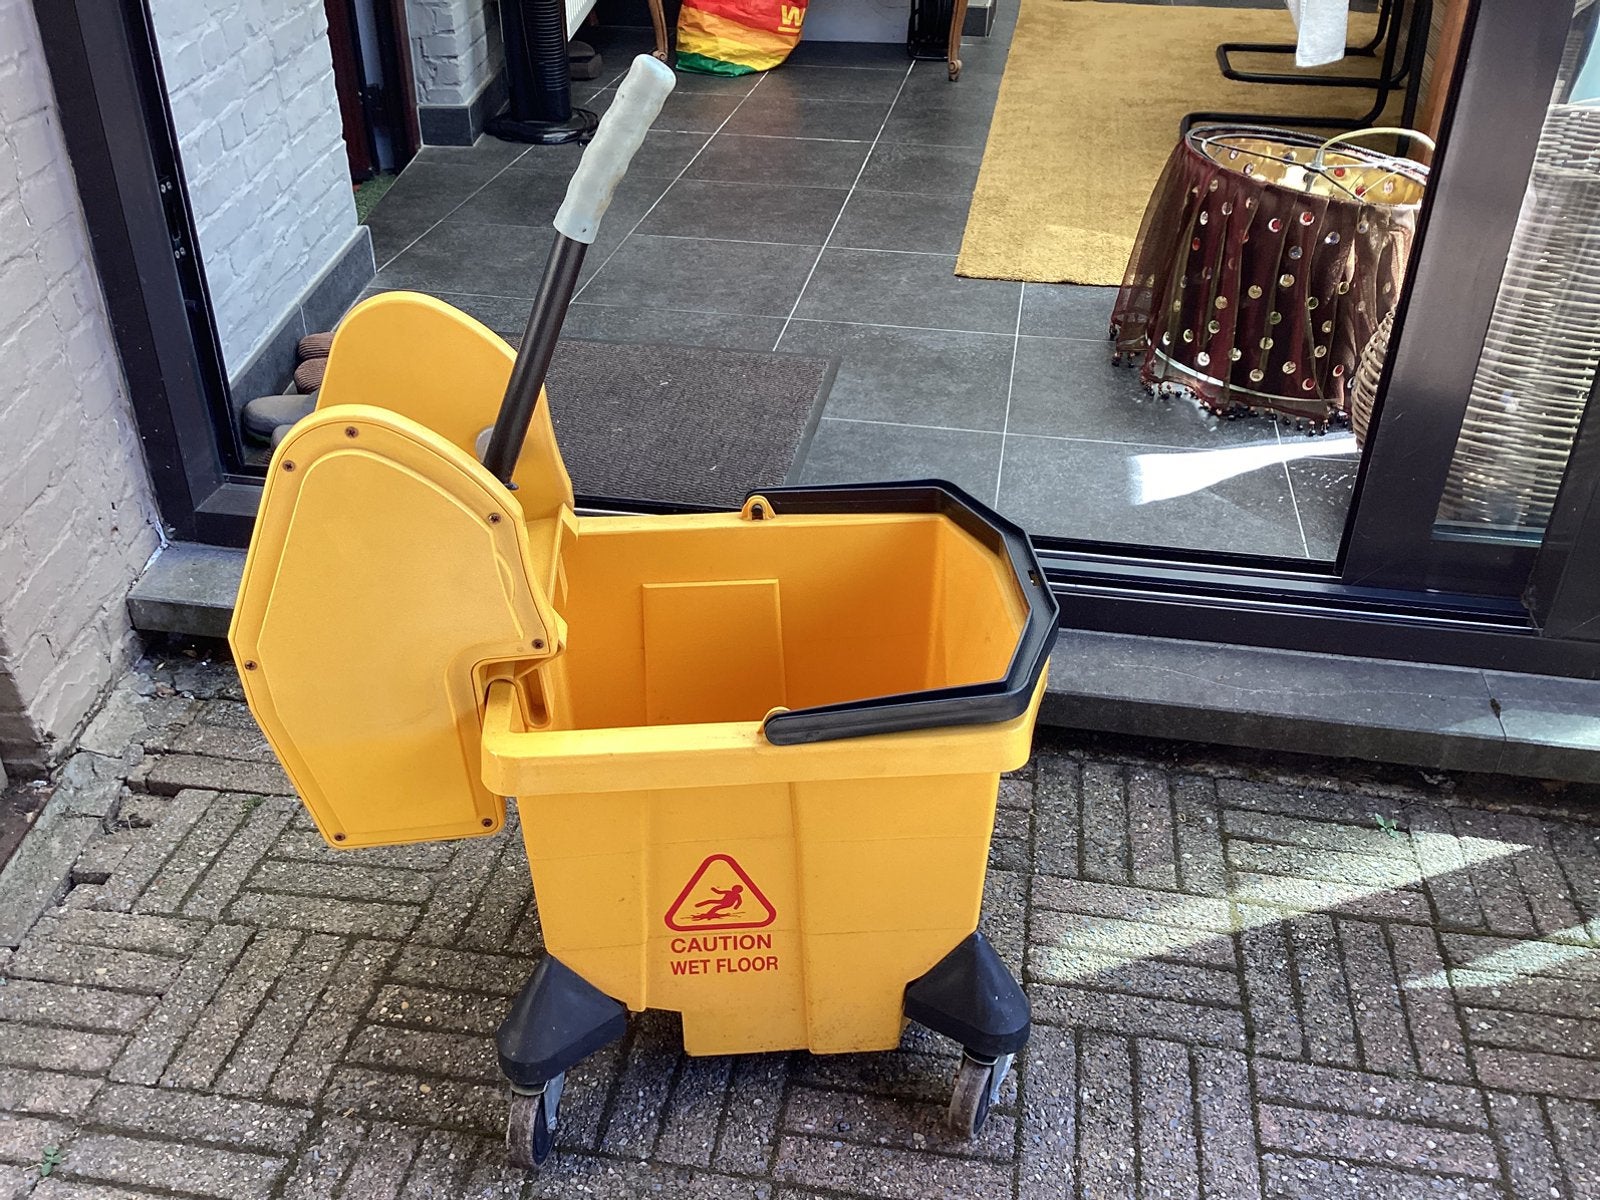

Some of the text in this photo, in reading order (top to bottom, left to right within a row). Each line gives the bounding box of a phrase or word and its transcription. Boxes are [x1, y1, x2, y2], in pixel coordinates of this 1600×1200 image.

[670, 934, 772, 953] CAUTION
[670, 956, 778, 975] WET FLOOR
